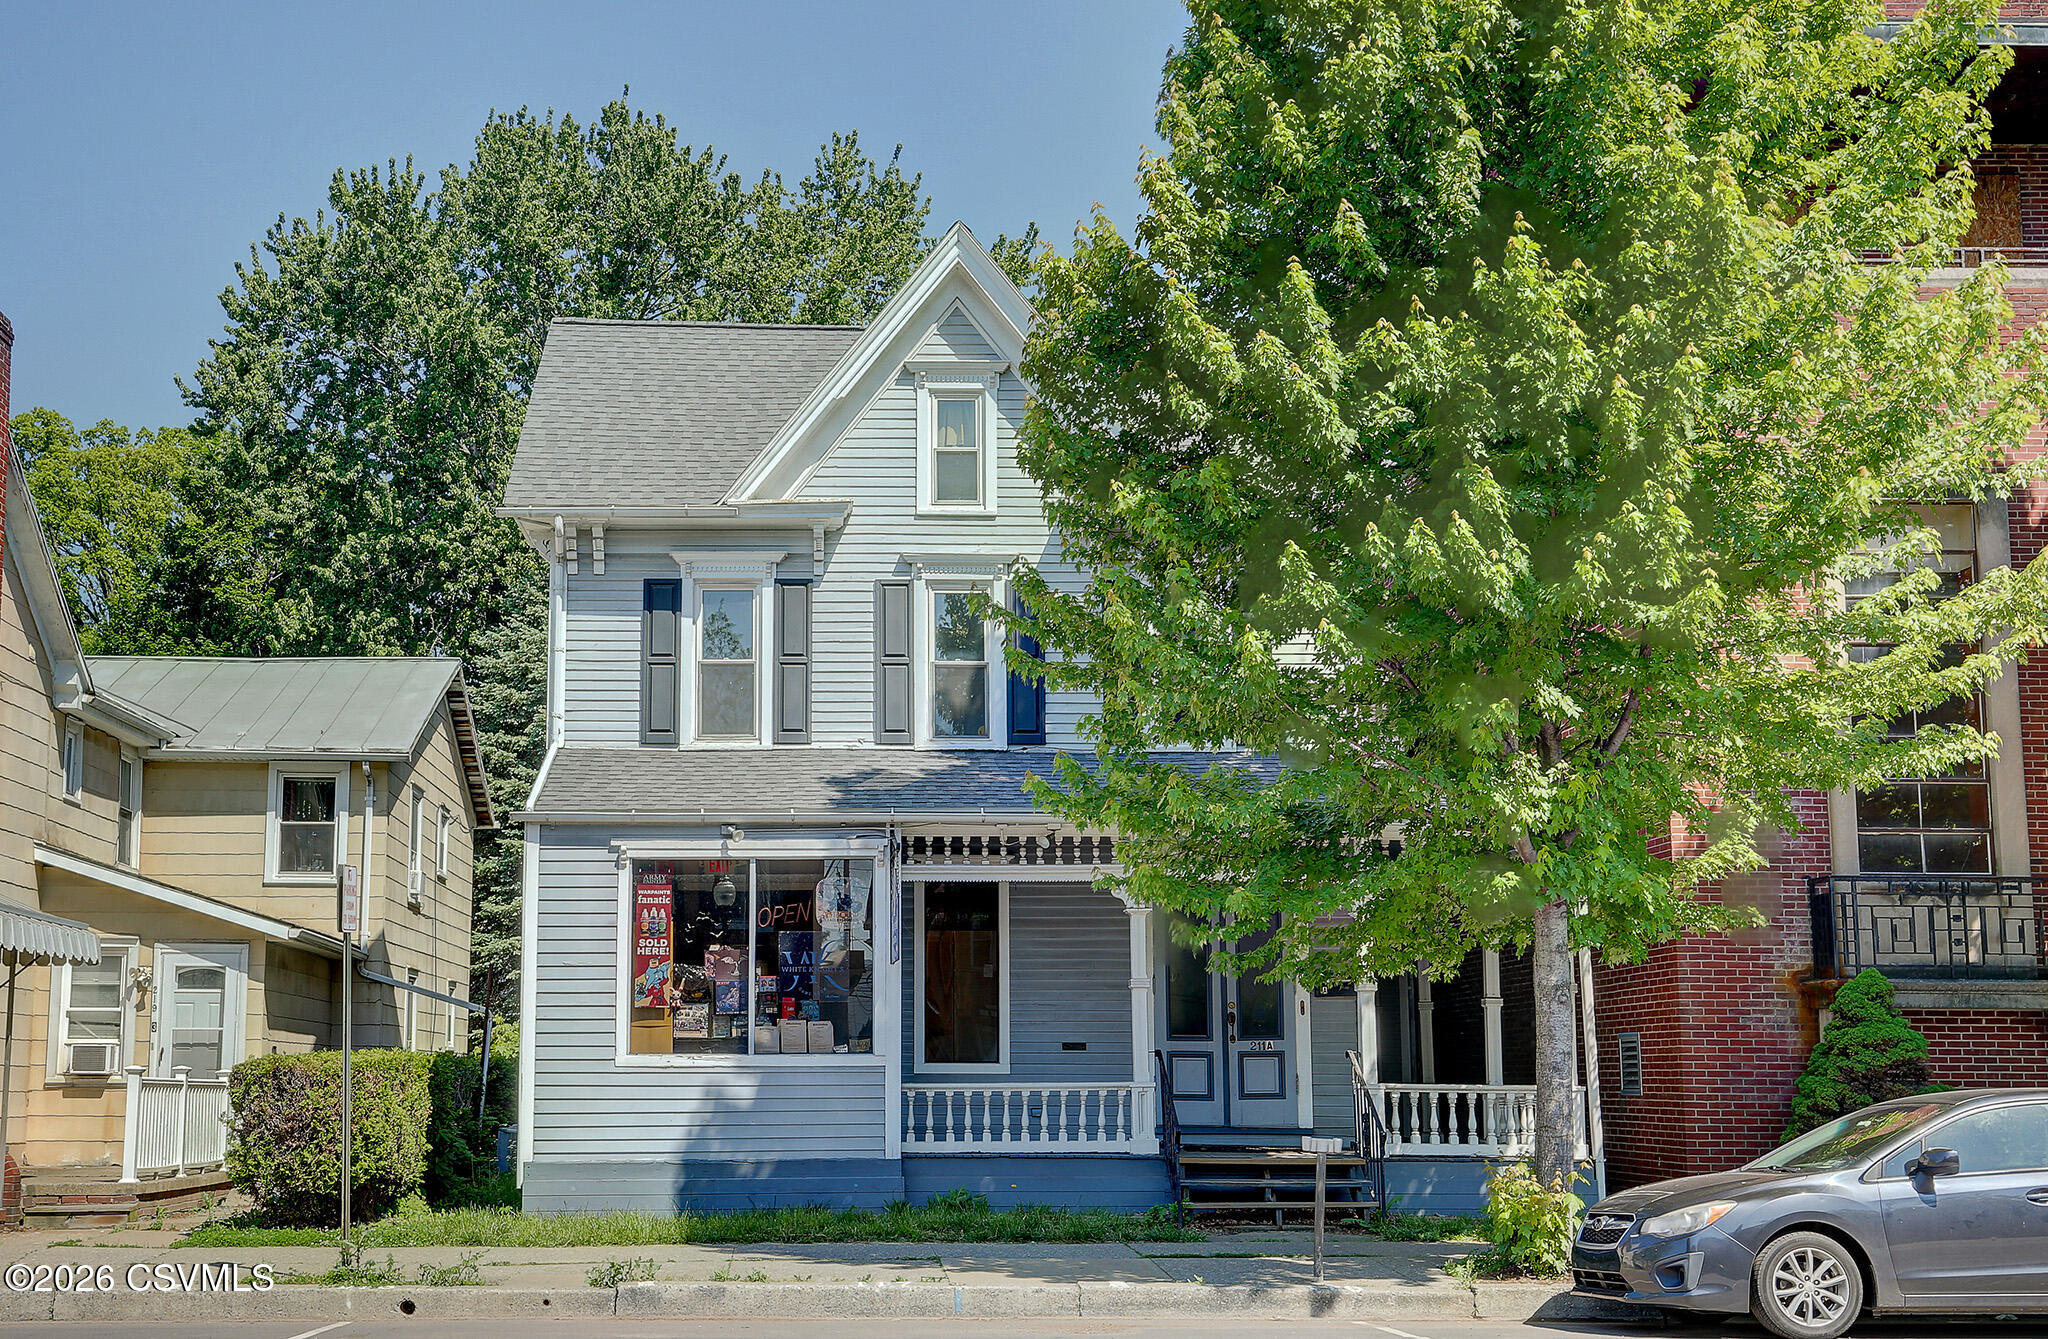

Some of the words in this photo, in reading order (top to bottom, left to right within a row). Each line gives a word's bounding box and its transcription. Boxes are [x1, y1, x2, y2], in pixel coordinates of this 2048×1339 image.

[643, 873, 667, 881] ARMY
[637, 895, 671, 904] fanatic
[758, 900, 811, 928] OPEN
[638, 938, 668, 947] SOLD
[636, 947, 670, 956] HERE!
[1250, 1041, 1275, 1051] 211A
